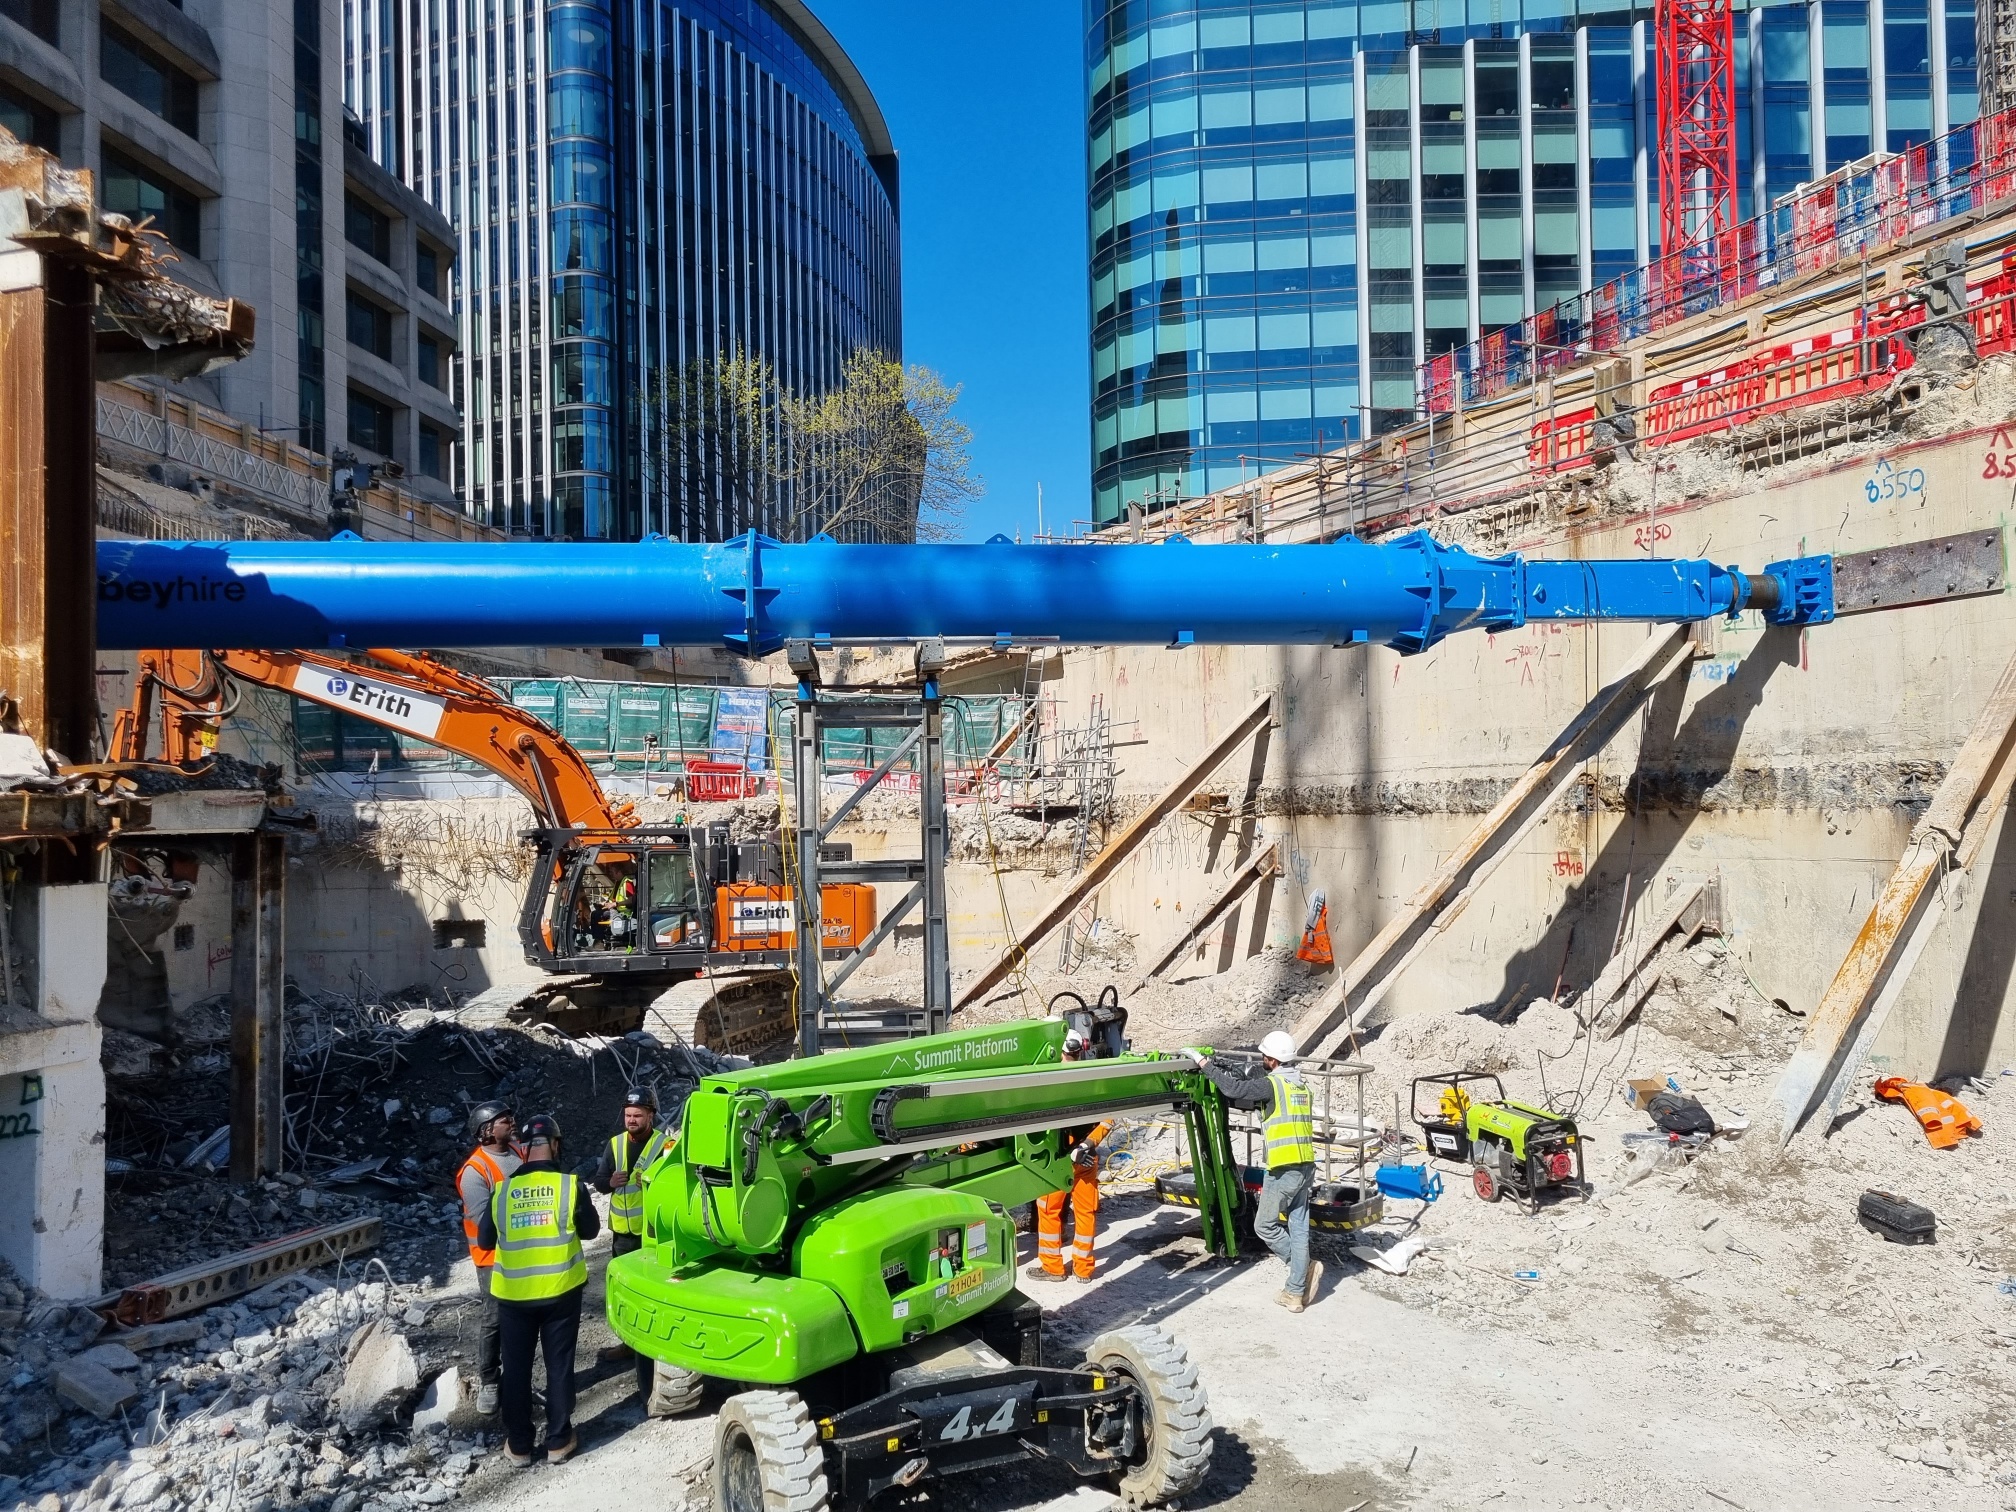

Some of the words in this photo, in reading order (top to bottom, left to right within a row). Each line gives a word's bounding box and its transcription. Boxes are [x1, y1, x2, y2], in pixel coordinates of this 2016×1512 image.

[1864, 466, 1926, 503] 8.550
[348, 682, 412, 718] Erith
[728, 698, 762, 706] HERAS
[914, 1044, 962, 1071] Summit
[964, 1037, 1018, 1061] Platforms
[513, 1201, 541, 1210] SAFETY
[522, 1186, 554, 1199] Erith
[949, 1271, 982, 1295] 21H041
[955, 1286, 983, 1307] Summit
[983, 1273, 1009, 1294] Platforms
[617, 1298, 765, 1361] nifty
[940, 1397, 1017, 1443] 4x4
